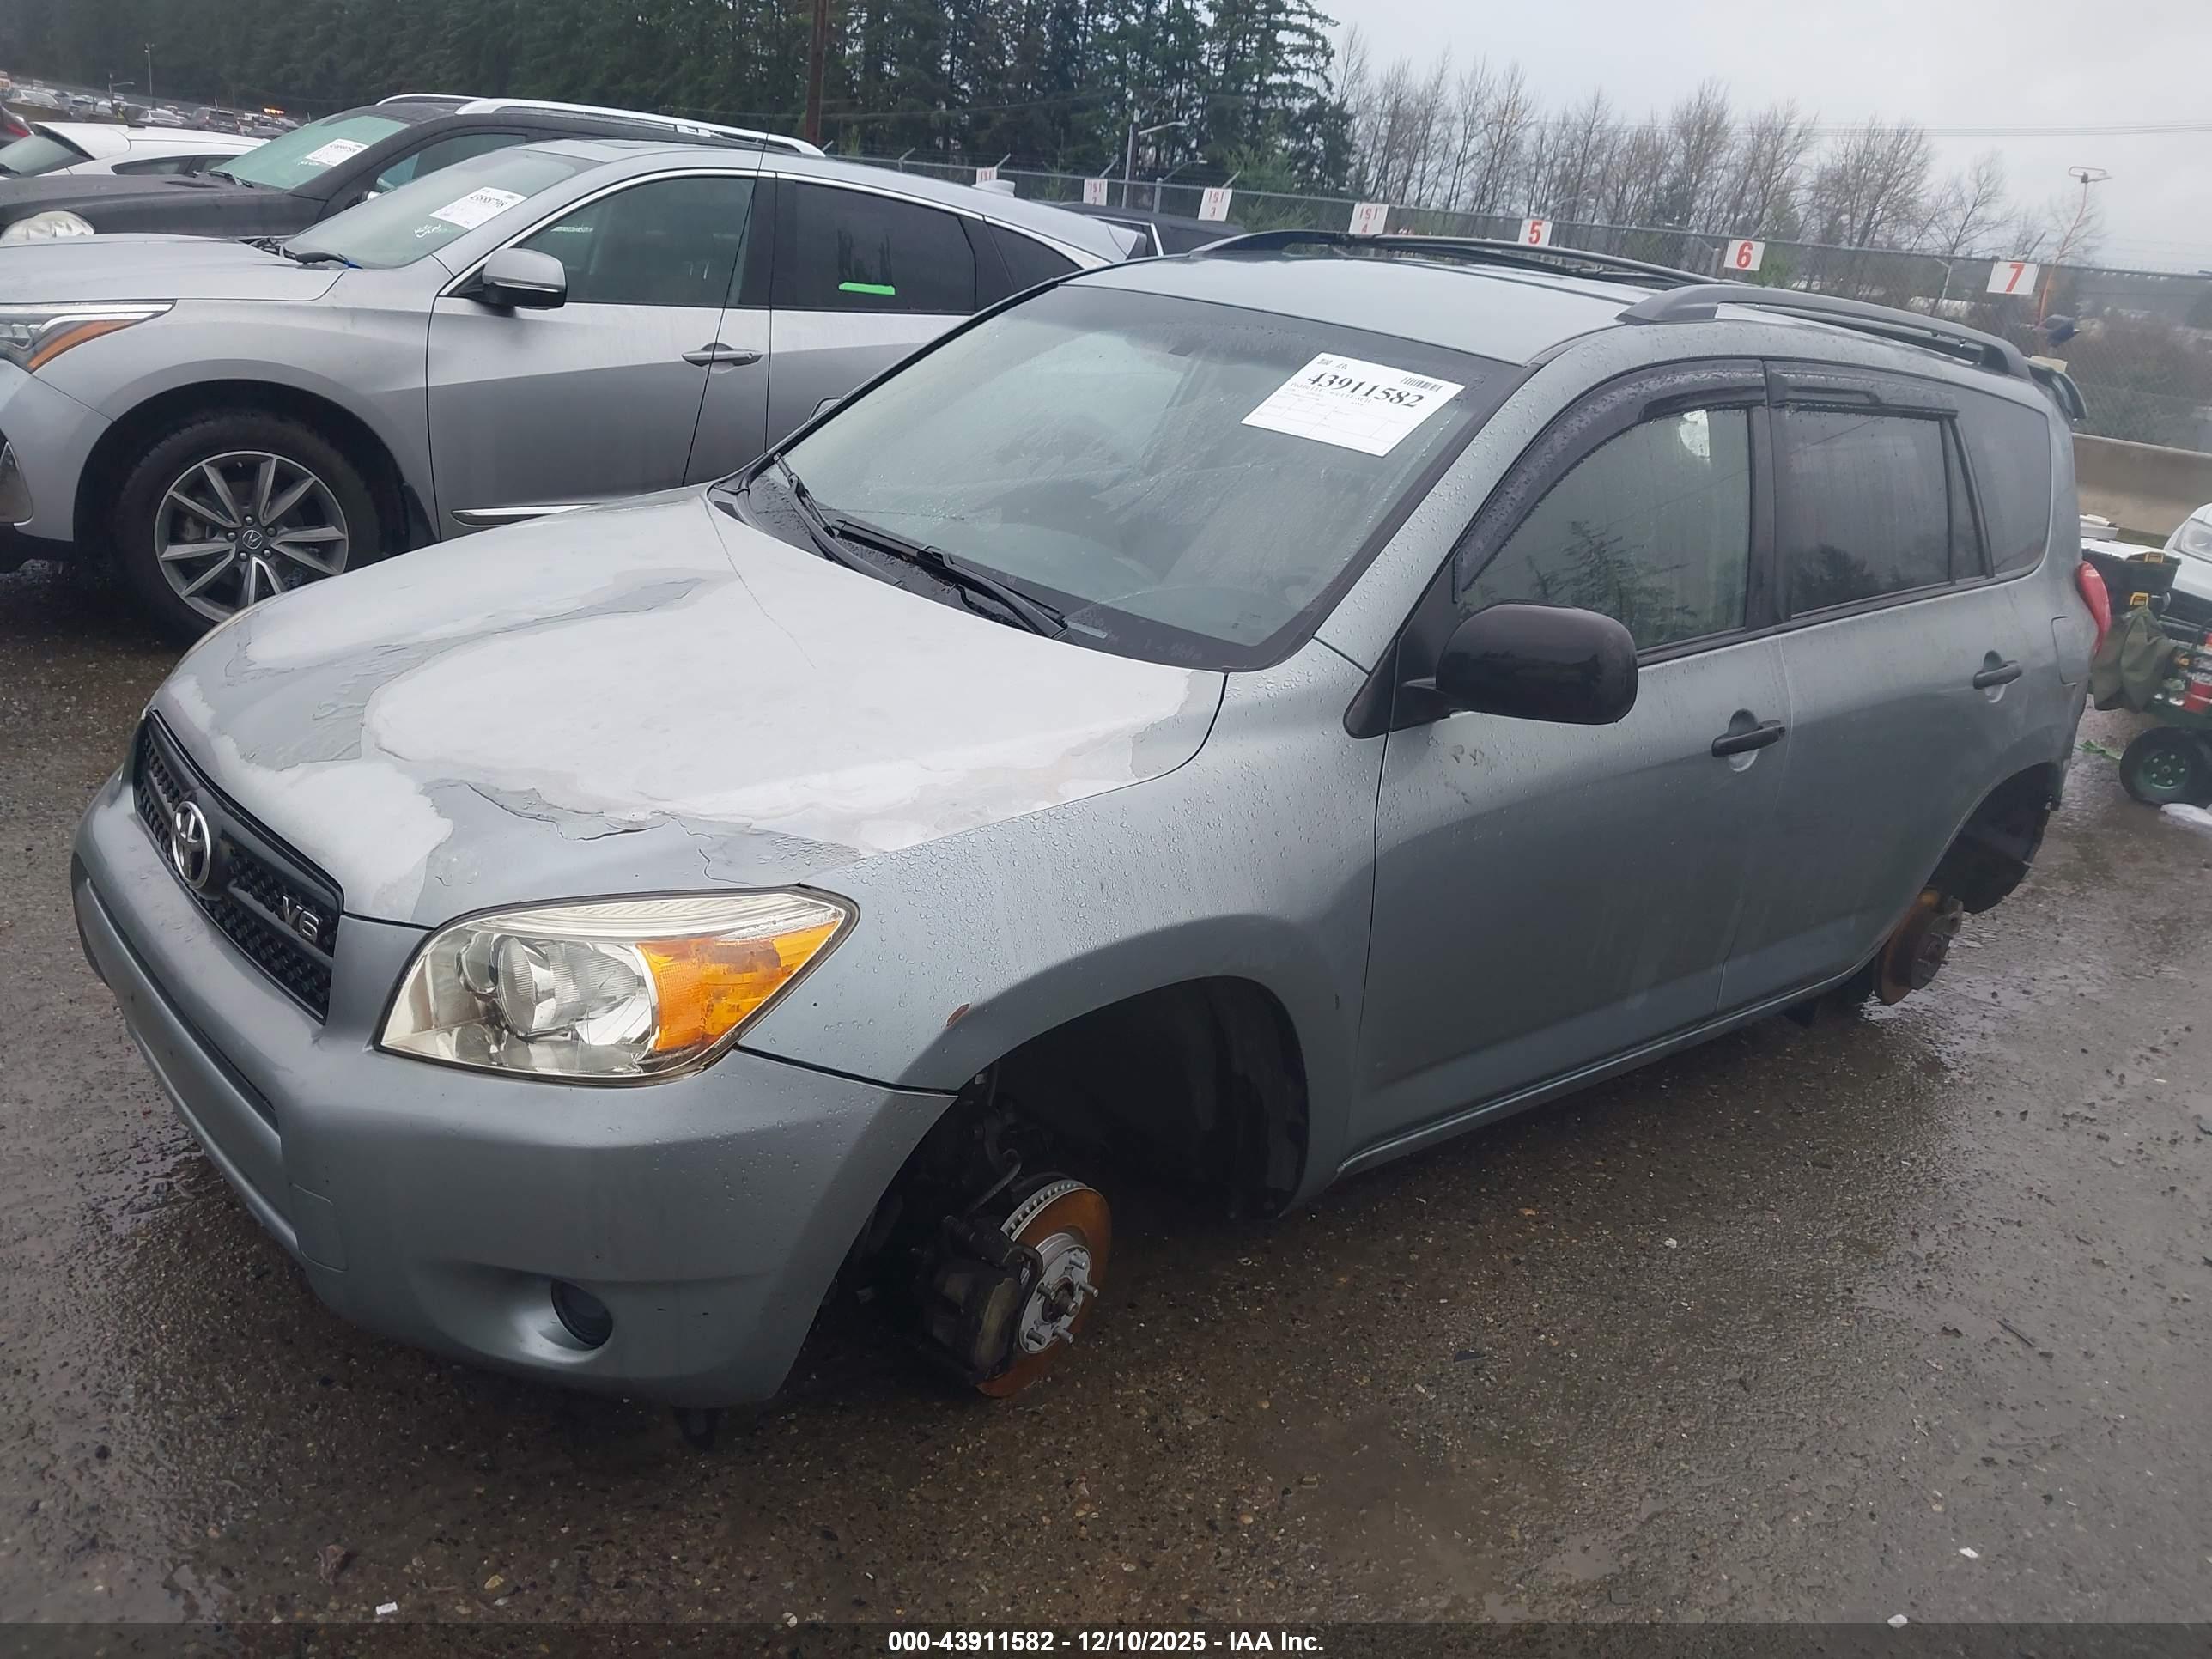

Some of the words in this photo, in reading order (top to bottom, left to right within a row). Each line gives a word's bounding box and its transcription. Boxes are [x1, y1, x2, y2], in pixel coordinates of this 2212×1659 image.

[1528, 220, 1543, 245] 5
[1736, 241, 1753, 269] 6
[2005, 262, 2025, 293] 7
[1307, 371, 1425, 408] 43911582
[283, 895, 319, 944] V6
